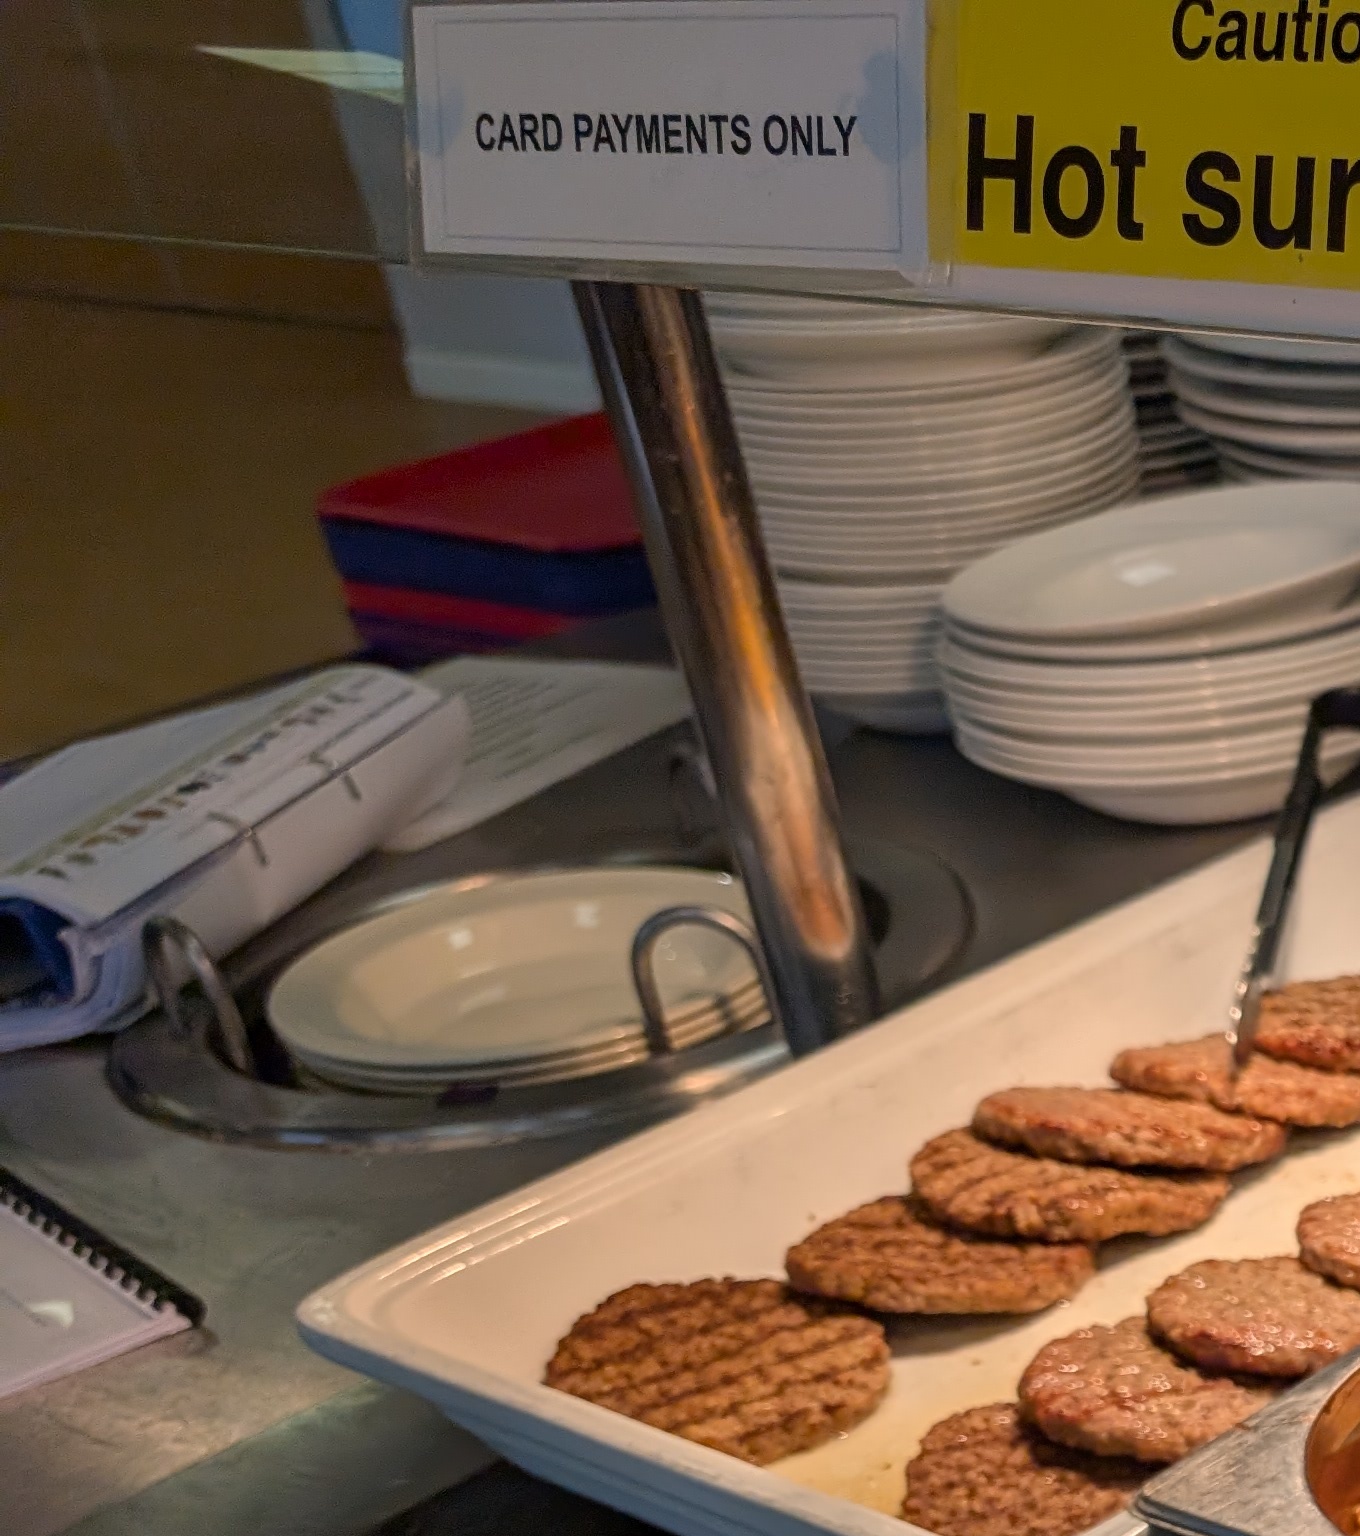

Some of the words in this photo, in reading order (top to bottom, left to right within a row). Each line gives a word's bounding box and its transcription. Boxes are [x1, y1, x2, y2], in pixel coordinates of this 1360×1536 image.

[475, 113, 563, 153] CARD
[573, 113, 752, 156] PAYMENTS
[763, 114, 858, 157] ONLY
[965, 112, 1147, 241] Hot
